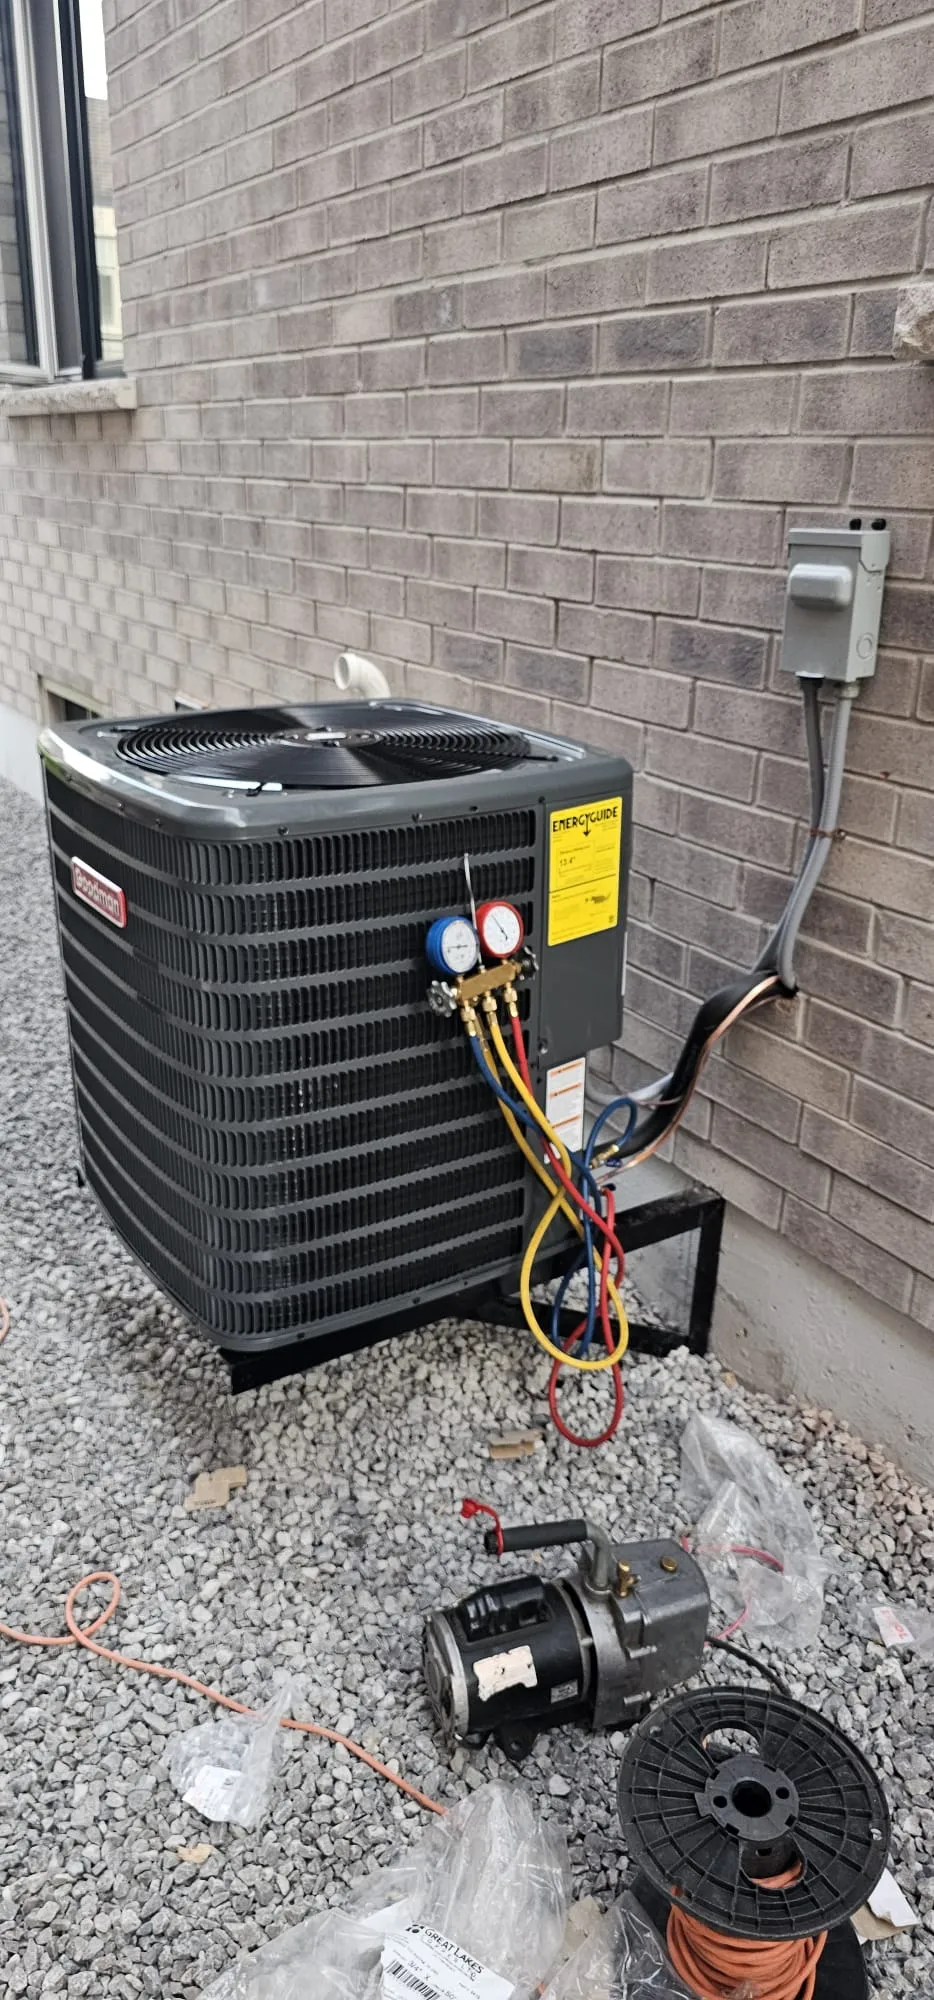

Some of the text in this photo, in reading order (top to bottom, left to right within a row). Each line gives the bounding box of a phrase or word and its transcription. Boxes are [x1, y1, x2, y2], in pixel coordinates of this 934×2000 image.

[552, 806, 618, 833] ENERGYGUIDE
[75, 866, 120, 916] Goodman
[424, 1928, 455, 1953] GREAT
[453, 1947, 485, 1974] LAKES
